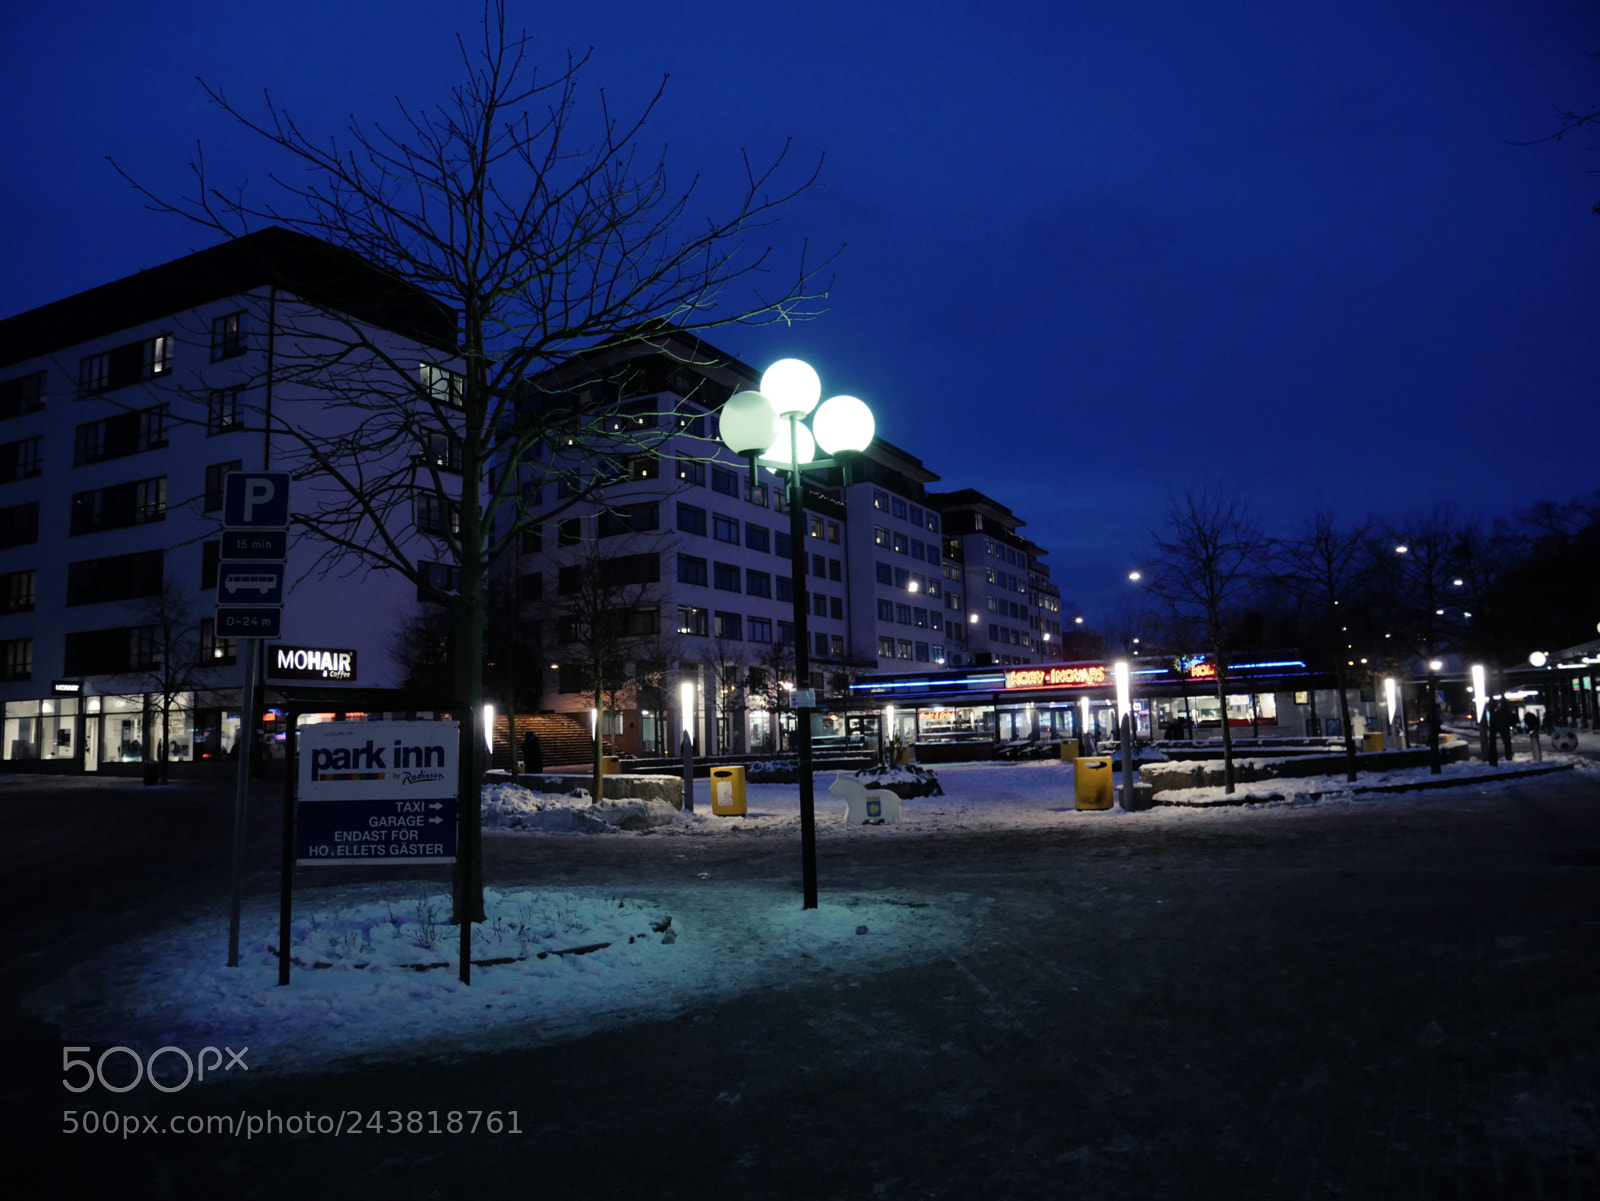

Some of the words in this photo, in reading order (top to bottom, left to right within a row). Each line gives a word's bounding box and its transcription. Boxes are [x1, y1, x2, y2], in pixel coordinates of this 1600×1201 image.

[243, 478, 275, 522] P
[236, 538, 248, 550] 15
[251, 538, 273, 550] min
[226, 616, 258, 627] 0-24
[261, 617, 272, 627] m
[277, 649, 351, 672] MOHAIR
[329, 670, 351, 679] Coffee
[311, 739, 387, 782] park
[393, 739, 445, 768] inn
[402, 769, 445, 785] Radisson
[395, 801, 426, 813] TAXI
[368, 815, 425, 828] GARAGE
[334, 830, 389, 842] ENDAST
[391, 828, 419, 841] FÖR
[308, 844, 387, 857] HOELLETS
[389, 842, 445, 856] GÄSTER
